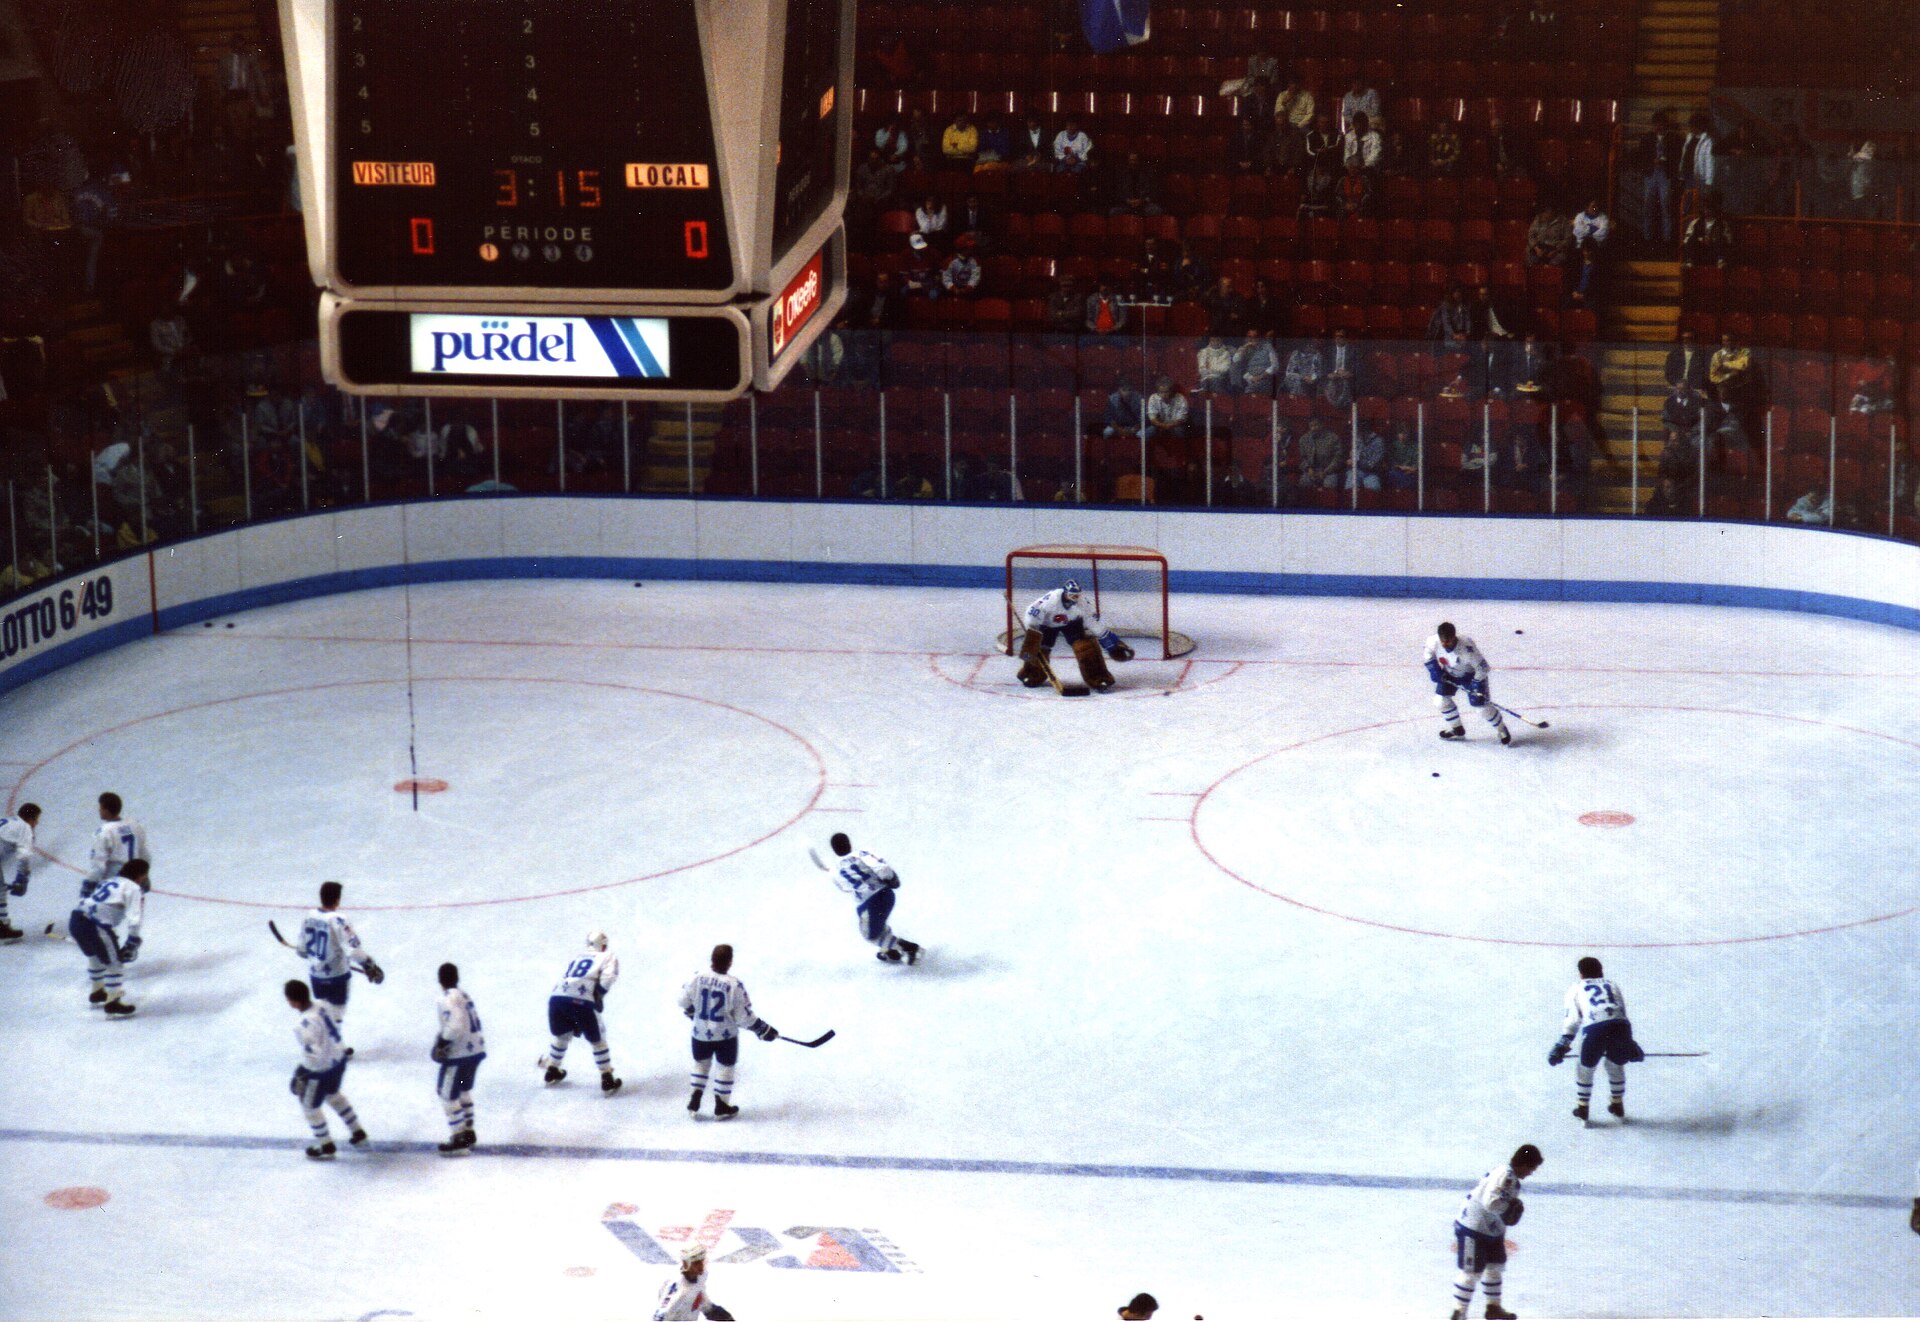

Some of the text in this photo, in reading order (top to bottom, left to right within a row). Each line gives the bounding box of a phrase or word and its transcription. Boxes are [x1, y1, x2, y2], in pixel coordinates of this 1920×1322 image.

[523, 19, 533, 34] 2
[525, 55, 535, 69] 3
[358, 85, 369, 100] 4
[527, 87, 538, 101] 4
[361, 120, 371, 134] 5
[529, 122, 540, 136] 5
[354, 162, 433, 184] VISITEUR
[633, 165, 700, 186] LOCAL
[410, 218, 434, 255] 0
[685, 221, 708, 258] 0
[0, 597, 57, 661] OTTO
[304, 926, 328, 961] 20
[699, 988, 725, 1022] 12
[1584, 983, 1618, 1006] 21
